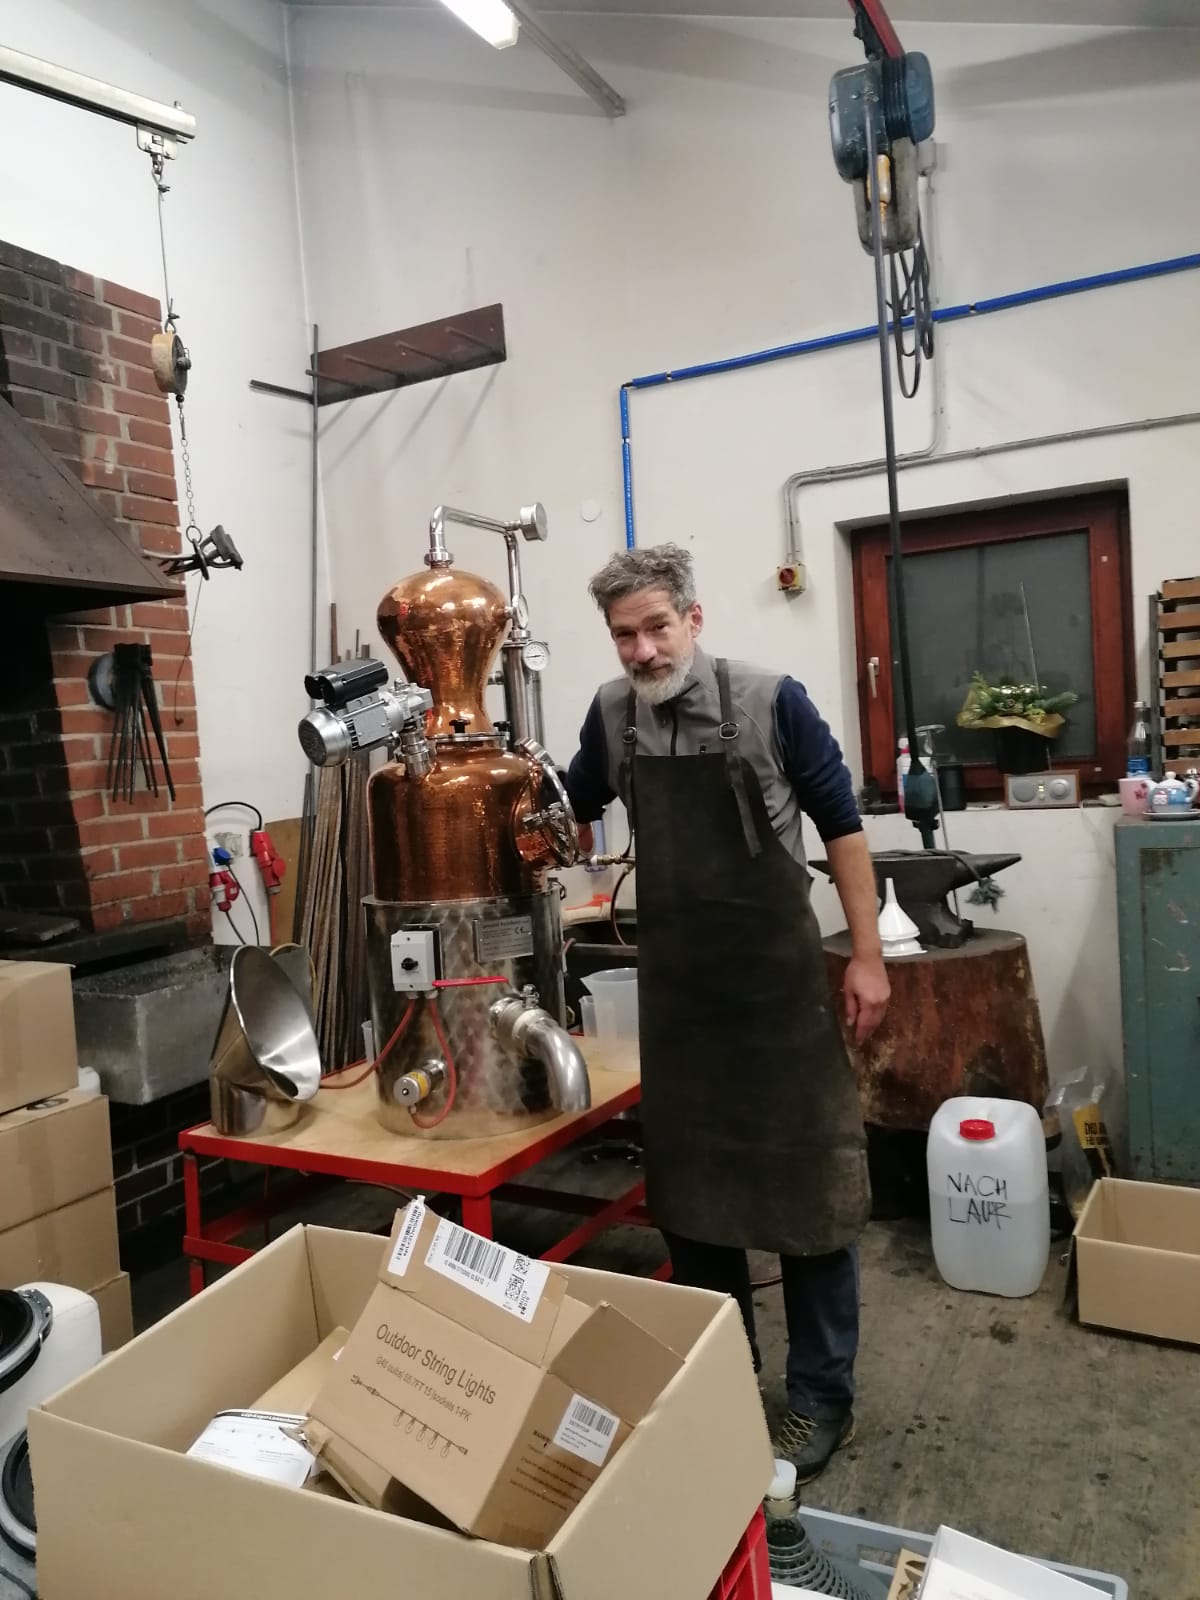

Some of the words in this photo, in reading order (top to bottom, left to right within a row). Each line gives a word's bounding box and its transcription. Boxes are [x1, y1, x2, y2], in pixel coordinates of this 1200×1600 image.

[947, 1172, 1007, 1201] NACH
[376, 1323, 422, 1360] Outdoor
[421, 1349, 457, 1385] String
[457, 1369, 496, 1404] Lights
